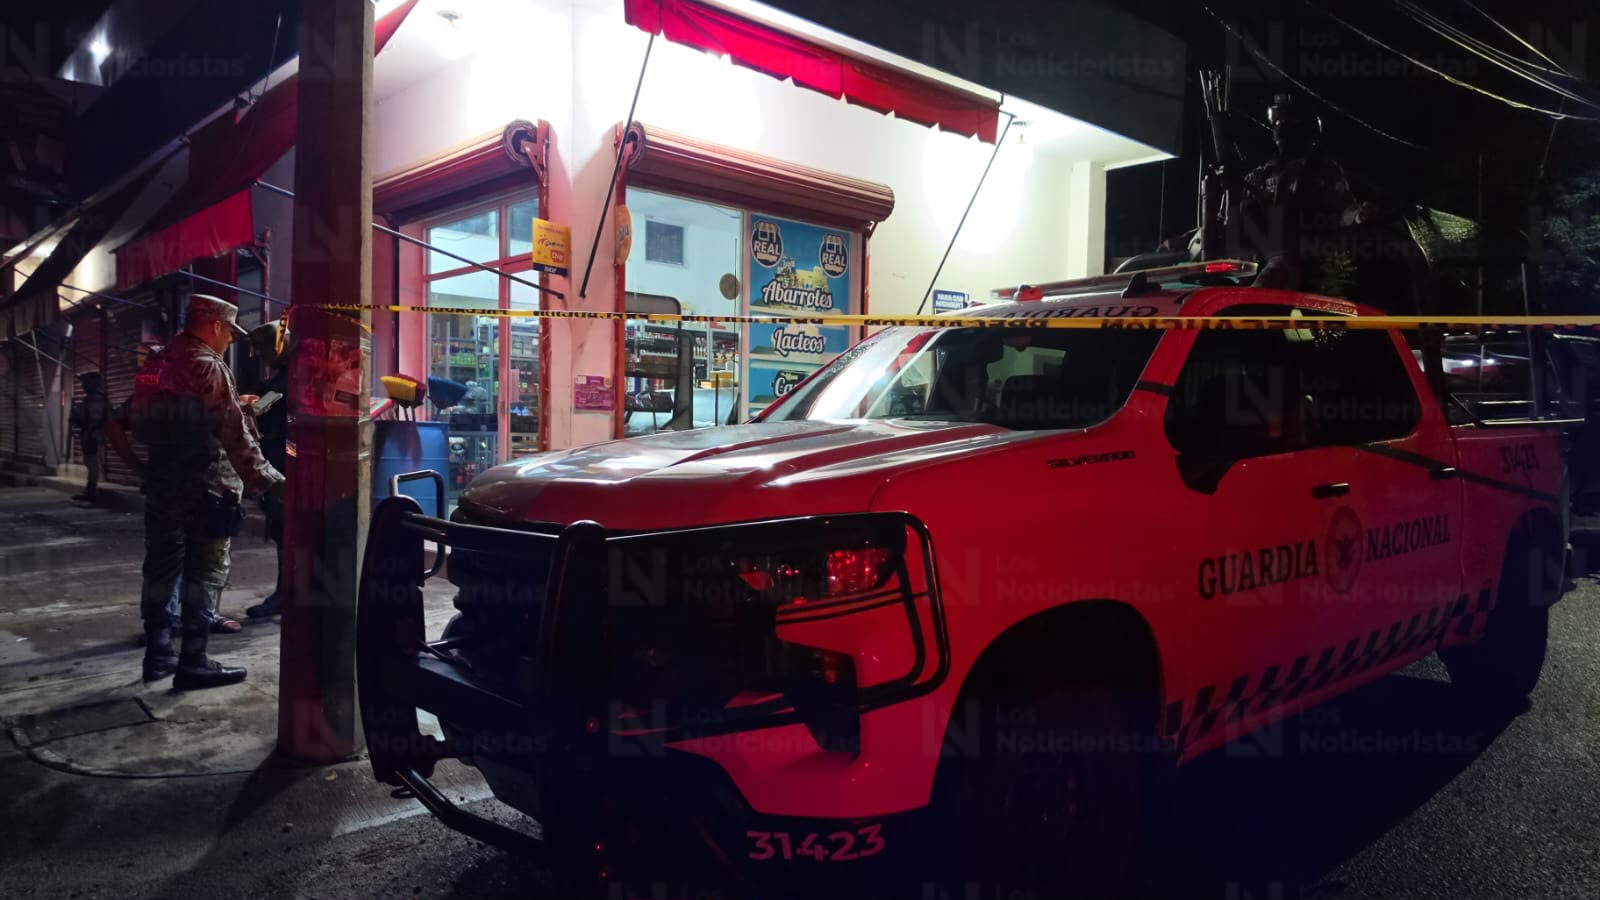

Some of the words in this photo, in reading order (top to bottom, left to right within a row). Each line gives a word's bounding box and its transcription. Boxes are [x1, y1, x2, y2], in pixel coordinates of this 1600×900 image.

[753, 241, 781, 256] REAL
[821, 253, 847, 267] REAL
[762, 280, 833, 309] Abarrotes
[773, 326, 825, 355] Lacteos
[1199, 540, 1318, 600] GUARDIA
[1366, 513, 1451, 562] NACIONAL
[745, 823, 886, 862] 31423
